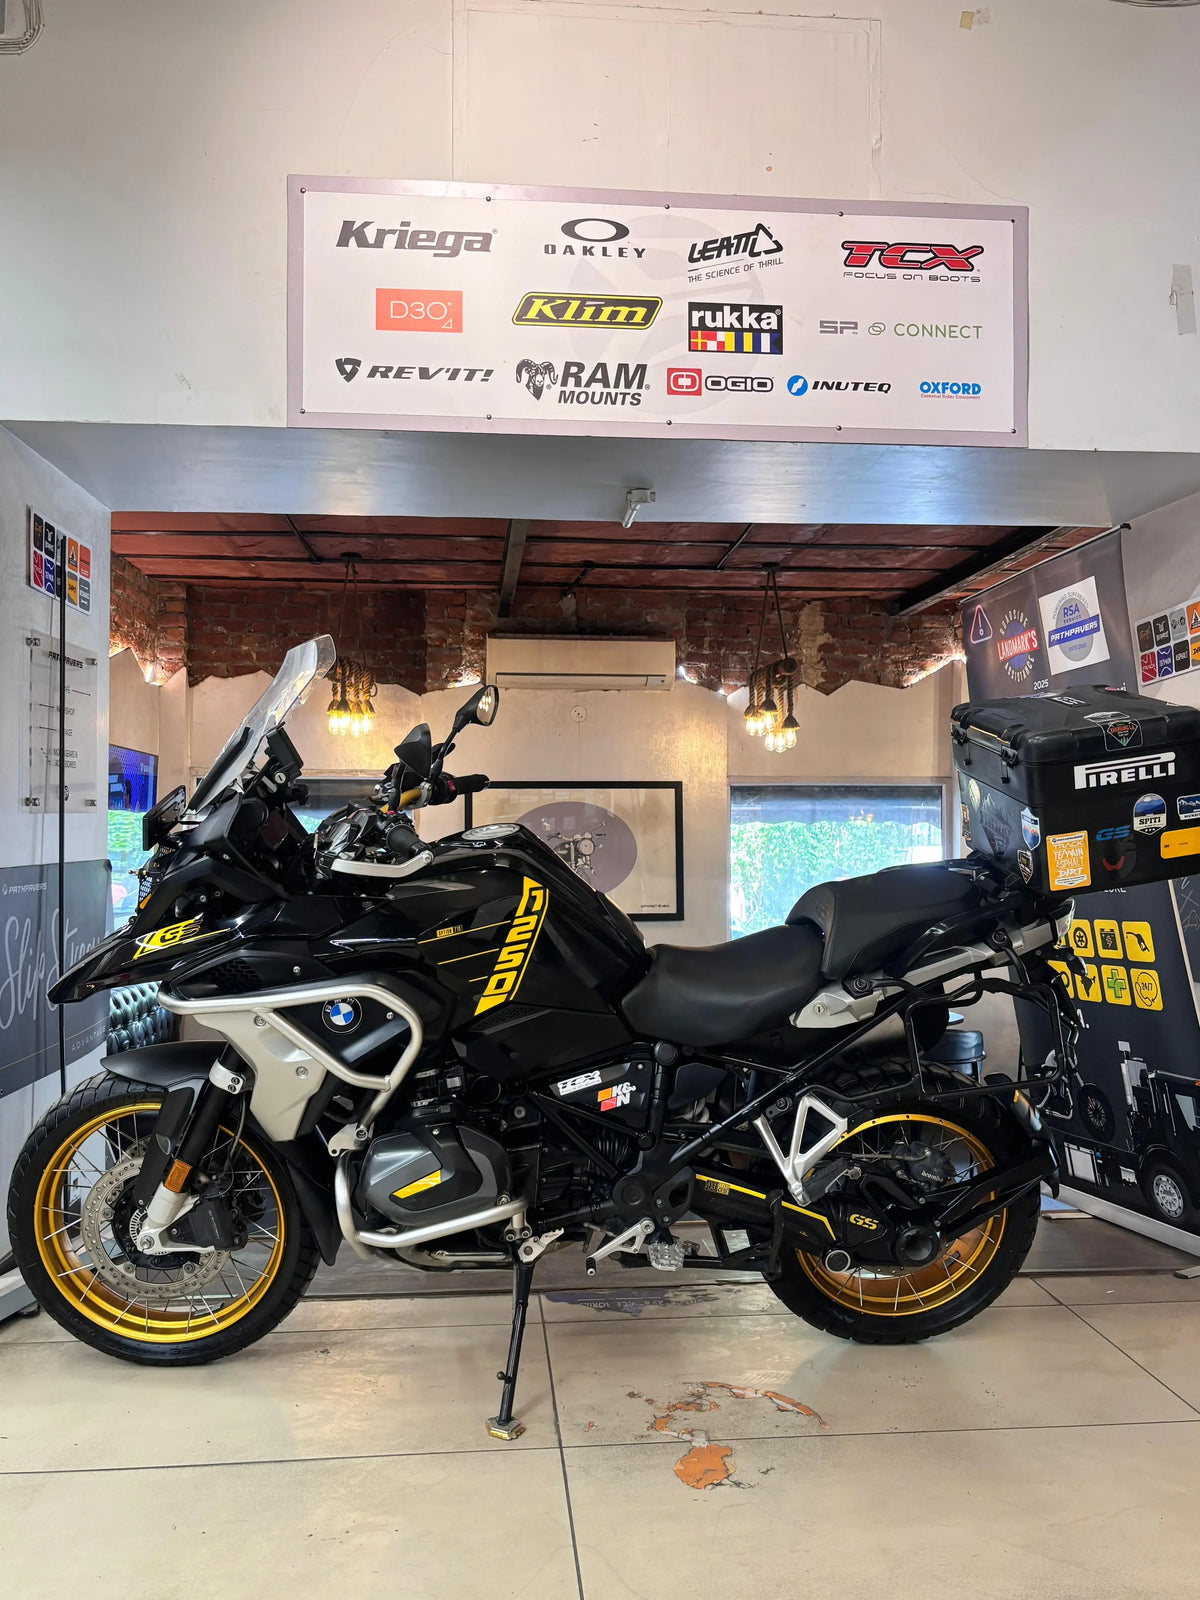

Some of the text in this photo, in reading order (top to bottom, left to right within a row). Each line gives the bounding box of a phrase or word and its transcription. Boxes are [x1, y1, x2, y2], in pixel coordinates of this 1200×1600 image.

[335, 220, 494, 258] Kriega
[544, 243, 647, 259] OAKLEY
[841, 240, 985, 272] TCX
[688, 257, 784, 284] THE SCIENCE OF THRILL
[843, 271, 981, 283] FOCUS ON BOOTS
[691, 305, 779, 331] rukka
[893, 323, 983, 340] CONNECT
[366, 363, 495, 383] REV'IT!
[560, 361, 649, 390] RAM
[705, 375, 775, 393] OGIO
[811, 380, 892, 394] INUTEQ
[919, 381, 982, 396] OXFORD
[557, 390, 642, 407] MOUNTS
[1063, 603, 1080, 618] RSA
[1050, 621, 1099, 643] PATHPAVERS
[998, 630, 1038, 660] LANDMARK'S
[1033, 679, 1049, 691] 2025
[1073, 752, 1176, 790] PIRELLI
[1139, 816, 1161, 826] SPITI
[1096, 825, 1131, 841] GS
[1053, 840, 1084, 850] TRACK
[1056, 867, 1084, 879] DIRT
[482, 890, 543, 996] 1250
[1141, 982, 1153, 992] 24/7
[325, 997, 355, 1013] BMW
[611, 1082, 637, 1098] K&
[616, 1093, 631, 1108] N
[850, 1213, 879, 1230] GS
